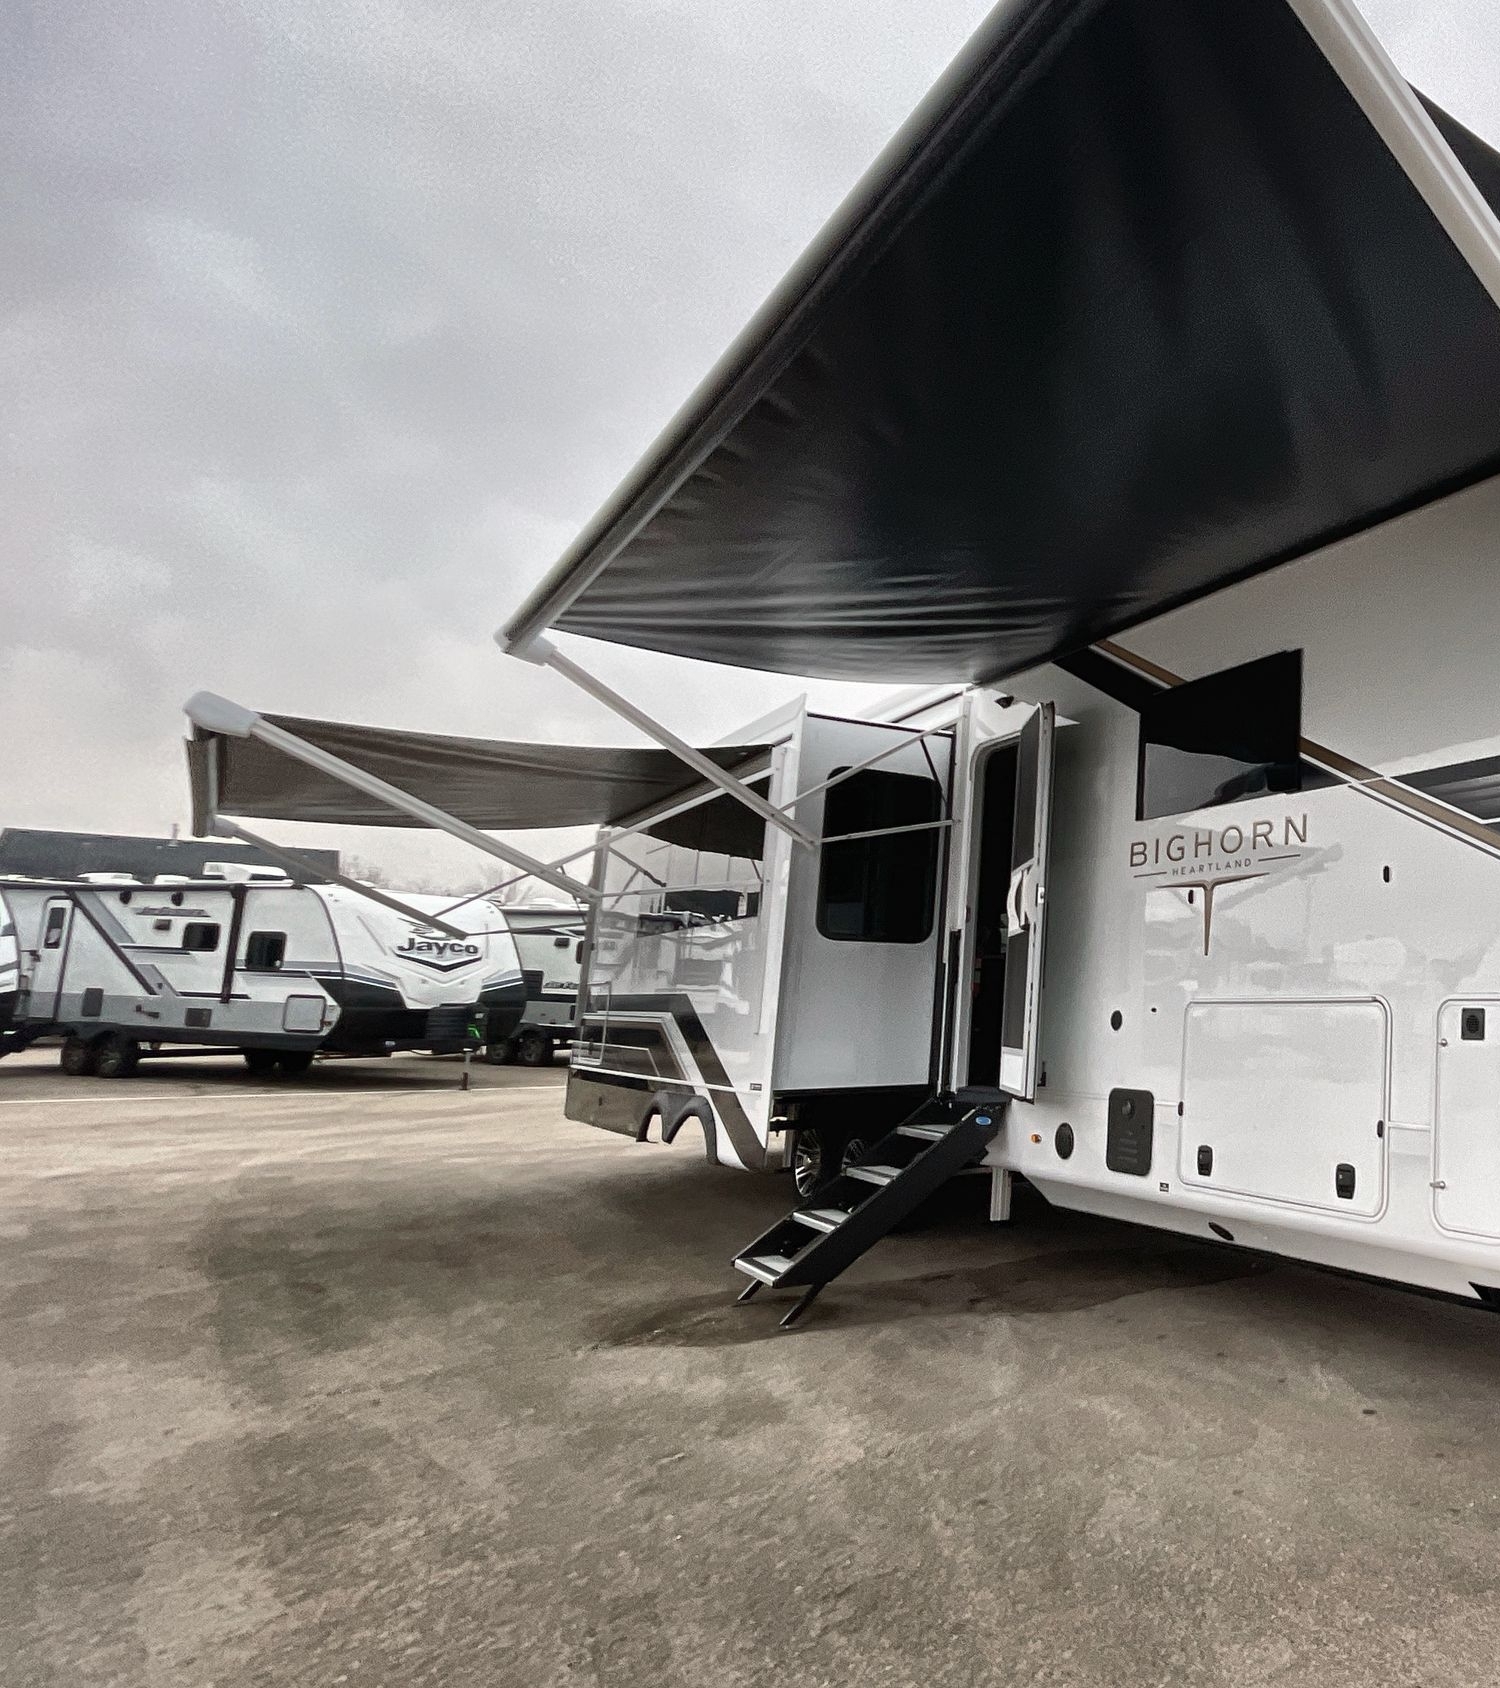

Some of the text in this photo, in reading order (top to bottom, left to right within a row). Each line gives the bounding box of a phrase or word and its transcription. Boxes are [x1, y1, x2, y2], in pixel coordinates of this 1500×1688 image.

[1130, 813, 1307, 867] BIGHORN
[1172, 858, 1251, 876] HEARTLAND
[397, 938, 479, 955] Jayco
